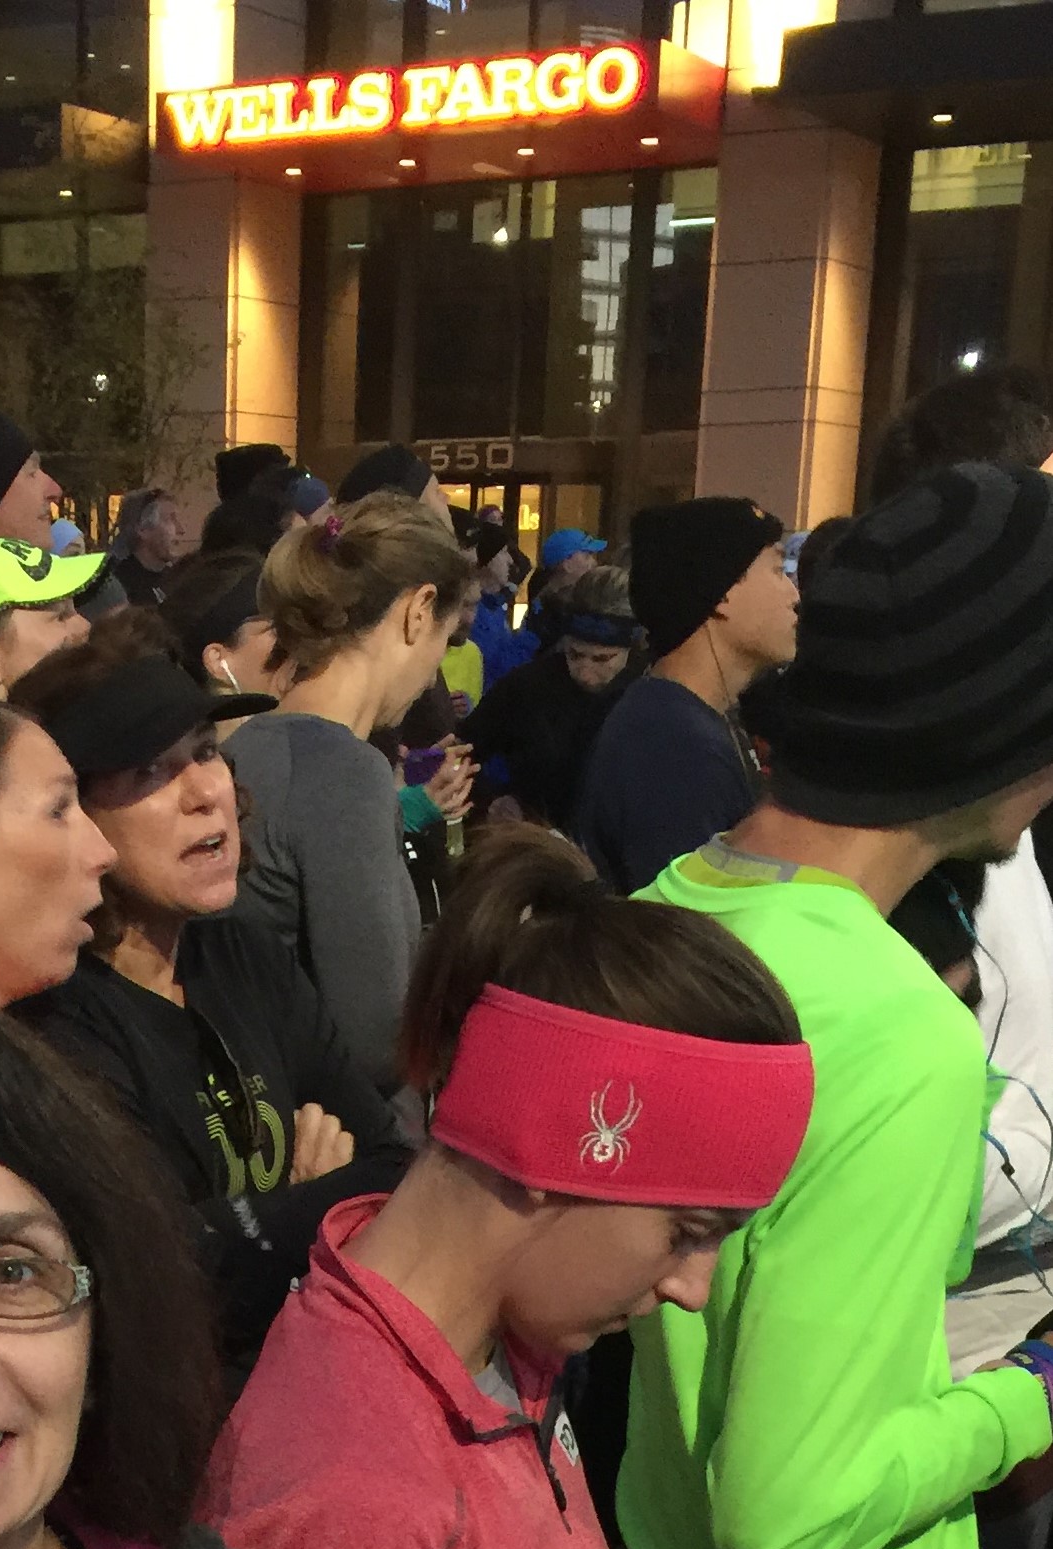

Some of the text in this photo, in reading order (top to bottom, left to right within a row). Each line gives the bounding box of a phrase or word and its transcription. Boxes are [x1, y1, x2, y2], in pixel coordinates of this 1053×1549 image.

[166, 45, 641, 148] WELLS FARGO
[430, 442, 514, 472] 550
